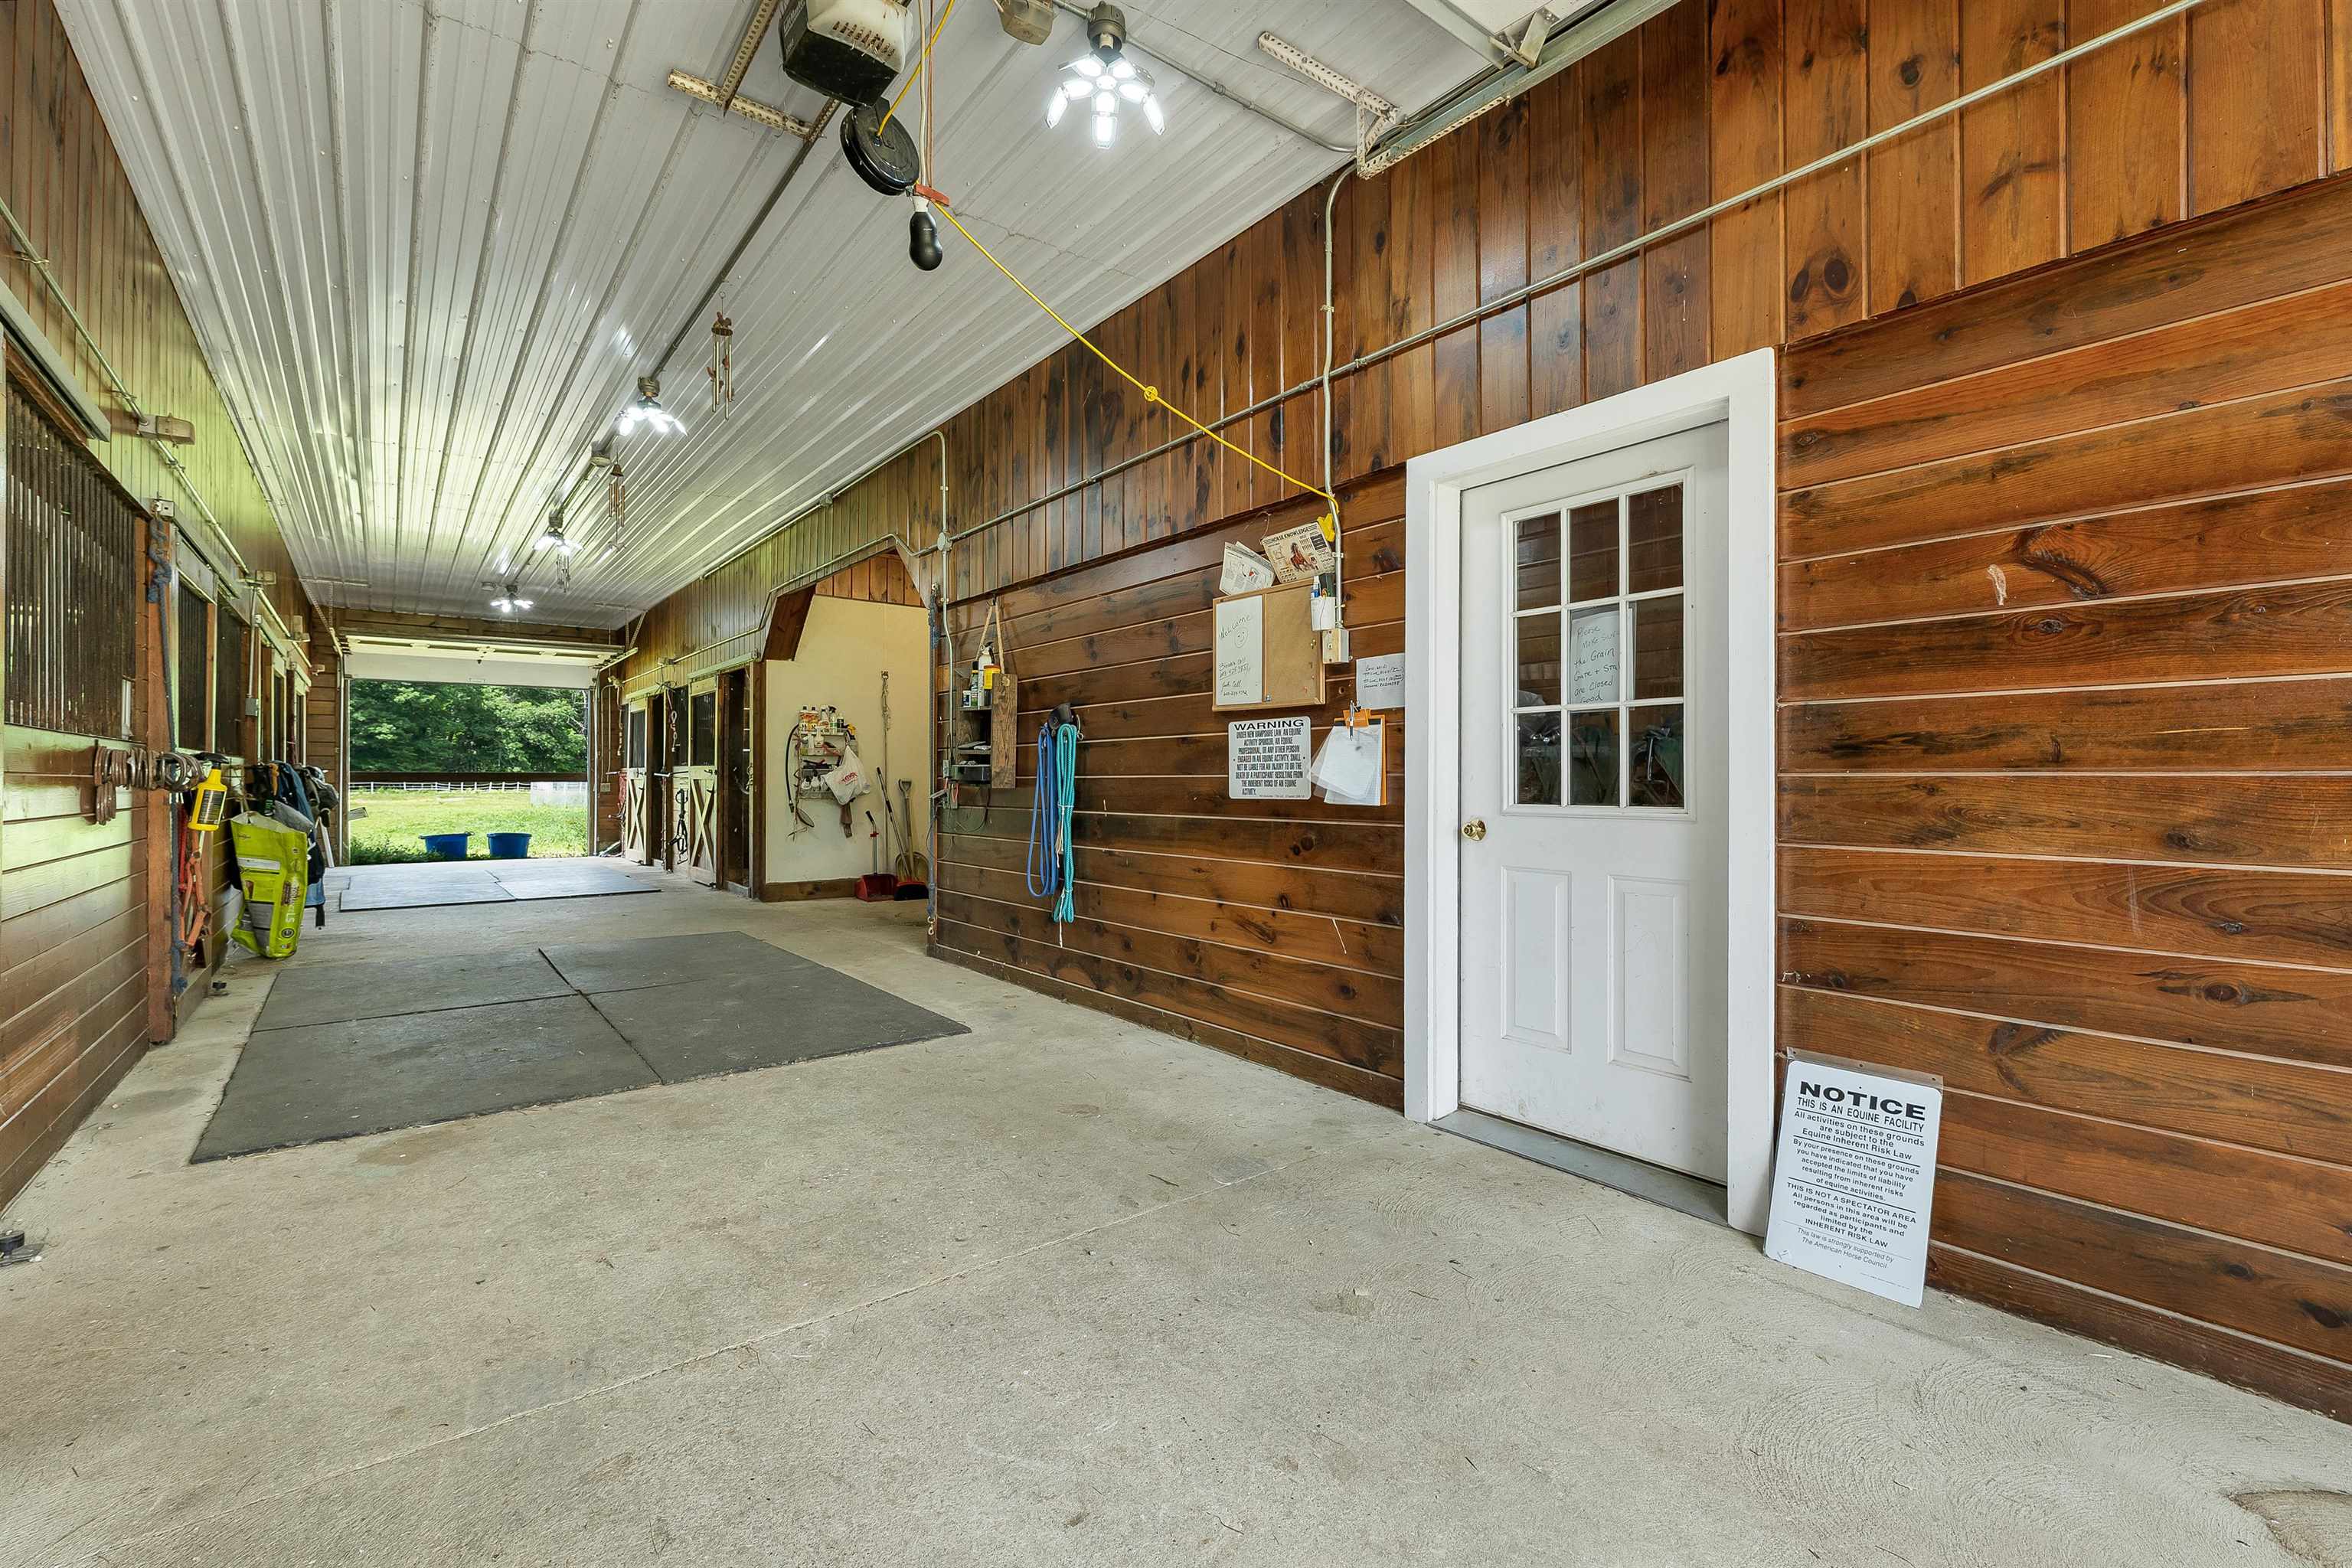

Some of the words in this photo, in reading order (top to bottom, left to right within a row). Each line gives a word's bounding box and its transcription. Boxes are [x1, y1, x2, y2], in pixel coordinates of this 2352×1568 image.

[1284, 527, 1308, 539] KNOWLEDGE
[1219, 614, 1252, 641] Welcome
[1577, 626, 1600, 637] Please
[1574, 658, 1586, 668] the
[1591, 648, 1615, 662] Grain
[1574, 671, 1592, 681] Gate
[1574, 688, 1585, 697] are
[1589, 674, 1613, 691] Closed
[1580, 690, 1603, 704] Good
[1234, 720, 1304, 730] WARNING
[1255, 729, 1273, 737] HAMPSHIRE
[1798, 1096, 1815, 1109] THIS
[1819, 1102, 1827, 1111] IS
[1831, 1104, 1844, 1115] AN
[1847, 1108, 1880, 1123] EQUINE
[1884, 1116, 1924, 1132] FACILITY
[1800, 1081, 1926, 1121] NOTICE
[1795, 1111, 1805, 1119] All
[1807, 1114, 1844, 1129] activities
[1860, 1125, 1884, 1137] these
[1886, 1132, 1925, 1147] grounds
[1820, 1125, 1833, 1133] are
[1835, 1128, 1867, 1142] subject
[1880, 1137, 1894, 1148] the
[1793, 1138, 1802, 1147] By
[1821, 1146, 1853, 1158] presence
[1865, 1156, 1886, 1167] these
[1887, 1163, 1919, 1175] grounds
[1802, 1128, 1831, 1141] Equine
[1833, 1135, 1869, 1149] Inherent
[1871, 1144, 1891, 1155] Risk
[1893, 1150, 1913, 1161] Law
[1802, 1158, 1833, 1170] accepted
[1834, 1165, 1846, 1174] the
[1847, 1168, 1867, 1179] limits
[1878, 1176, 1906, 1191] liability
[1811, 1151, 1828, 1161] have
[1828, 1155, 1861, 1168] indicated
[1863, 1164, 1878, 1173] that
[1879, 1168, 1893, 1177] you
[1895, 1171, 1913, 1182] have
[1802, 1165, 1833, 1179] resulting
[1834, 1174, 1851, 1184] from
[1852, 1178, 1883, 1192] inherent
[1884, 1187, 1904, 1197] risks
[1824, 1180, 1849, 1191] equine
[1850, 1187, 1886, 1201] activities.
[1787, 1182, 1804, 1192] THIS
[1815, 1189, 1831, 1200] NOT
[1841, 1197, 1890, 1217] SPECTATOR
[1892, 1212, 1916, 1223] AREA
[1804, 1194, 1834, 1210] persons
[1845, 1205, 1860, 1216] this
[1862, 1212, 1880, 1221] area
[1881, 1215, 1896, 1226] will
[1897, 1220, 1908, 1230] be
[1794, 1200, 1827, 1214] regarded
[1839, 1212, 1887, 1232] participants
[1889, 1228, 1905, 1237] and
[1821, 1215, 1847, 1228] limited
[1848, 1222, 1857, 1232] by
[1860, 1227, 1873, 1236] the
[1798, 1227, 1810, 1236] This
[1811, 1231, 1821, 1240] law
[1828, 1237, 1852, 1250] strongly
[1854, 1244, 1885, 1260] supported
[1886, 1253, 1895, 1263] by
[1805, 1218, 1846, 1235] INHERENT
[1847, 1231, 1867, 1243] RISK
[1869, 1236, 1888, 1248] LAW
[1802, 1236, 1813, 1245] The
[1814, 1241, 1842, 1255] American
[1843, 1250, 1862, 1261] Horse
